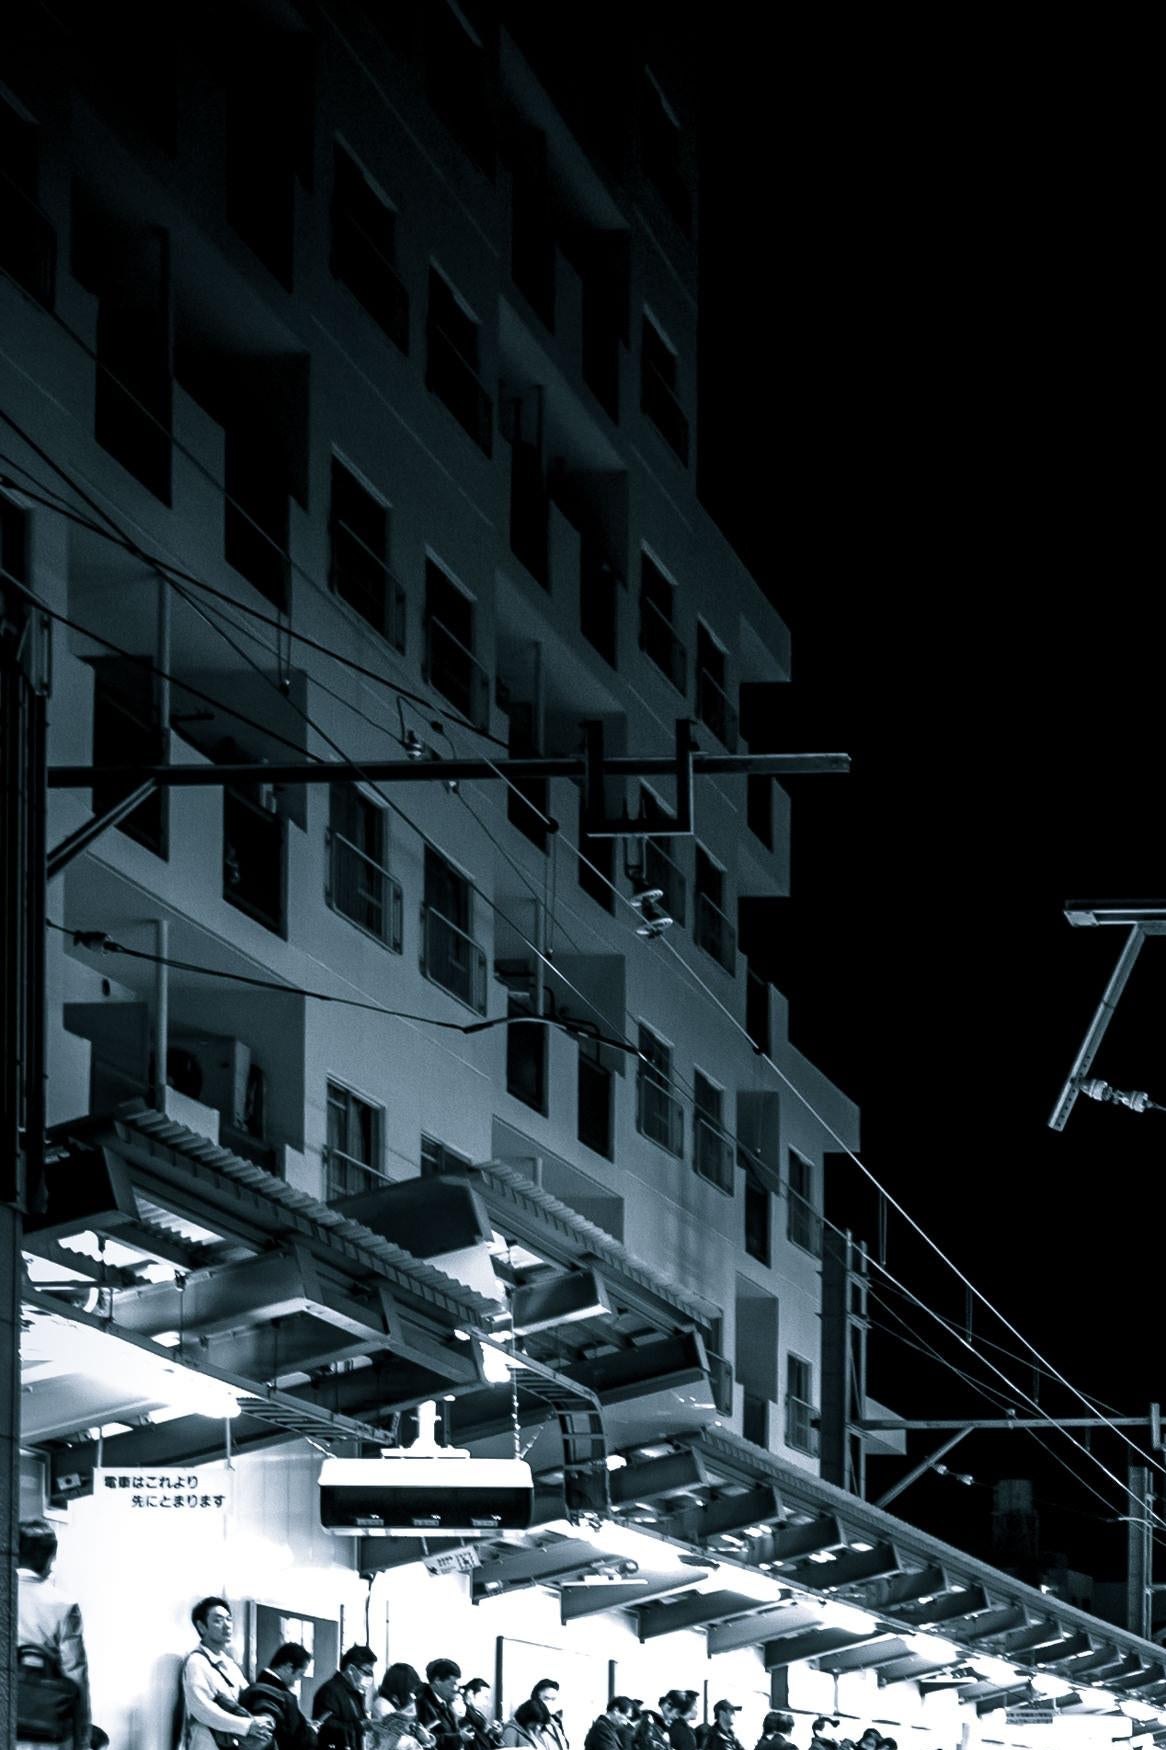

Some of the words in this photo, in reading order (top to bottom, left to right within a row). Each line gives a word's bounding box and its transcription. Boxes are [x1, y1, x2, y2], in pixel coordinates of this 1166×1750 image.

[104, 1475, 198, 1489] 電車はこれより
[132, 1495, 225, 1508] 先にとまります
